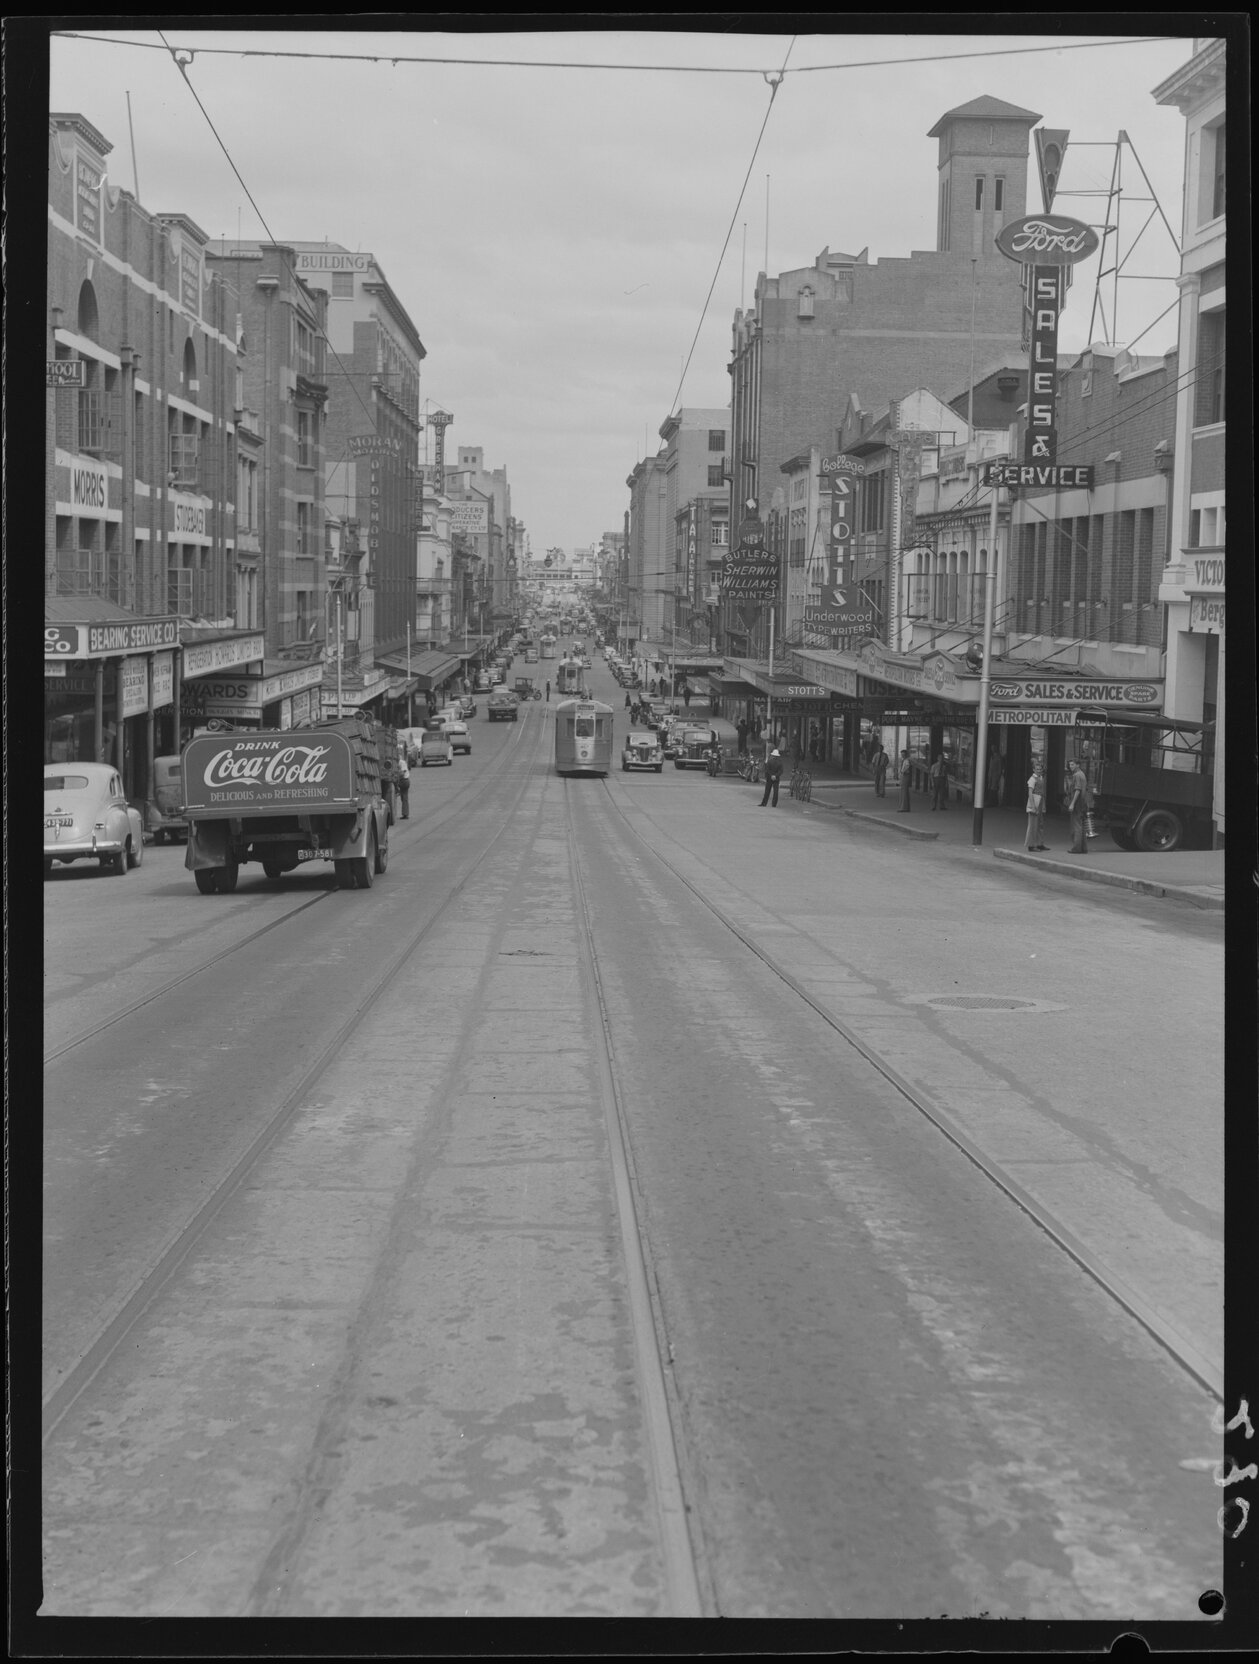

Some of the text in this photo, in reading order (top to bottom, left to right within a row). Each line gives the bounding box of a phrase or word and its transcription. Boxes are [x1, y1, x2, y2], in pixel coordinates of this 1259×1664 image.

[1012, 220, 1087, 253] Ford
[301, 255, 366, 270] BUILDING
[1032, 278, 1057, 427] SALES
[428, 414, 450, 423] HOTEL
[349, 436, 401, 451] MORAN
[1032, 435, 1051, 457] &
[989, 466, 1089, 486] SERVICE
[74, 469, 105, 509] MORRIS
[176, 504, 204, 534] STUDEBAKER
[370, 458, 380, 587] OLDSMOBILE
[725, 549, 778, 563] BUTLERS
[728, 590, 771, 600] PAINTS
[806, 610, 872, 623] Underwood
[91, 621, 175, 651] BEARING SERVICE CO
[806, 622, 872, 637] TYPEWRITERS
[788, 686, 826, 696] STOTT'S
[991, 683, 1020, 698] Ford
[1025, 684, 1065, 699] SALES
[1075, 685, 1123, 701] SERVICE
[235, 741, 283, 751] DRINK
[204, 745, 332, 788] Coca-Cola
[211, 787, 329, 802] DELICIOUS AND REFRESHING
